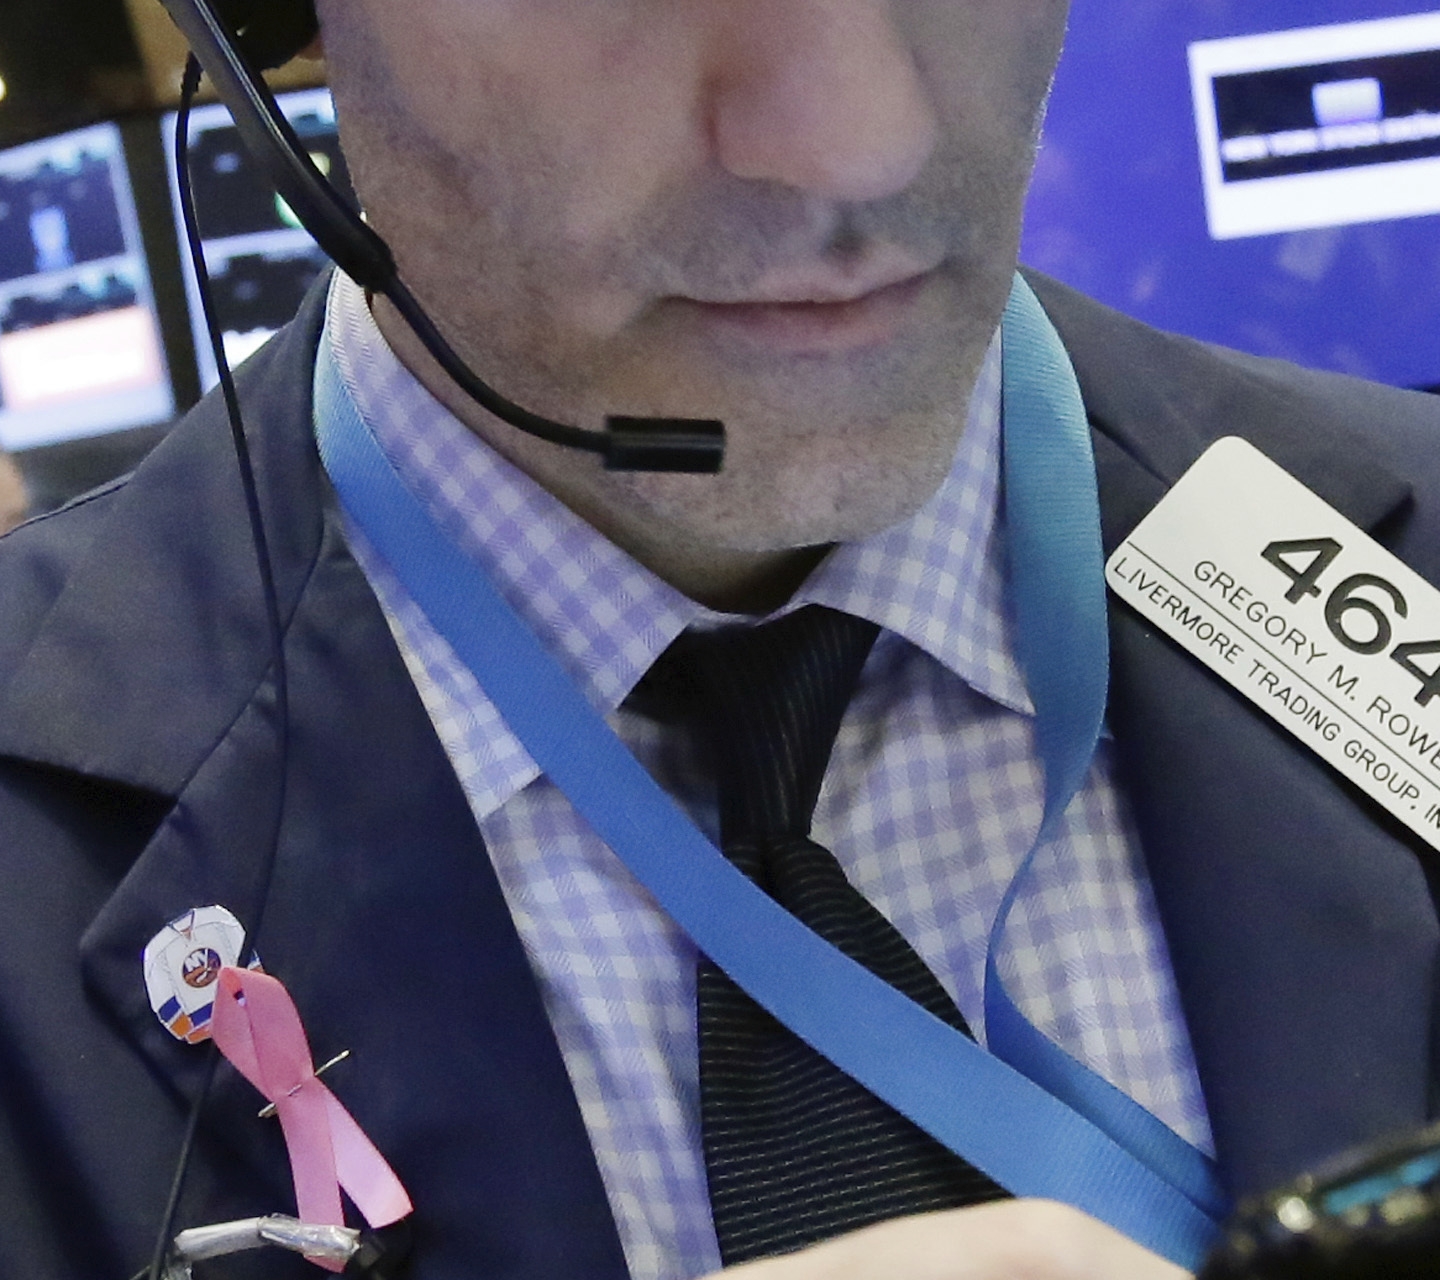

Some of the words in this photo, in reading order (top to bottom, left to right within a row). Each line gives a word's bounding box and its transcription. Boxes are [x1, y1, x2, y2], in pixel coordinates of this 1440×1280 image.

[1113, 556, 1245, 665] LIVERMORE
[1248, 658, 1342, 742] TRADING
[1194, 560, 1328, 665] GREGORY
[1327, 664, 1359, 702] M.
